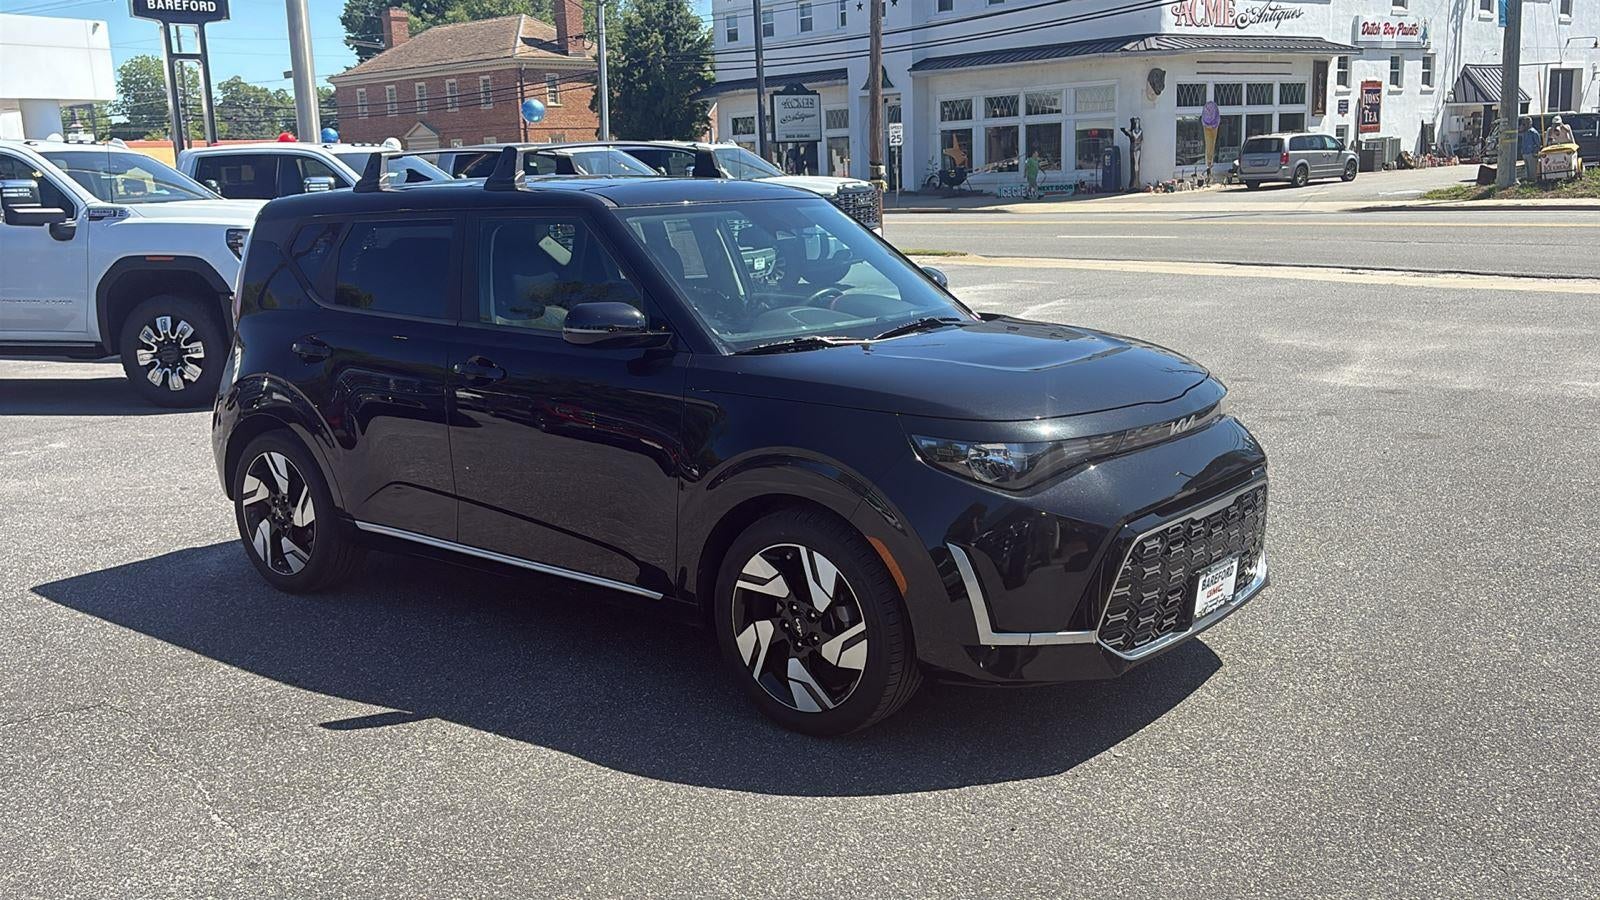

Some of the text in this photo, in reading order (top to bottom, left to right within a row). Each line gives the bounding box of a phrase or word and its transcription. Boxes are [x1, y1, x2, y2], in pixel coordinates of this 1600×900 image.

[147, 0, 217, 12] BAREFORD
[1171, 0, 1304, 29] ACME Antiques
[1361, 21, 1419, 39] Dutch Boy Paints
[1364, 110, 1378, 123] TEA
[890, 135, 902, 144] 25
[1201, 564, 1234, 592] BAREFORD
[1206, 583, 1224, 599] GMC
